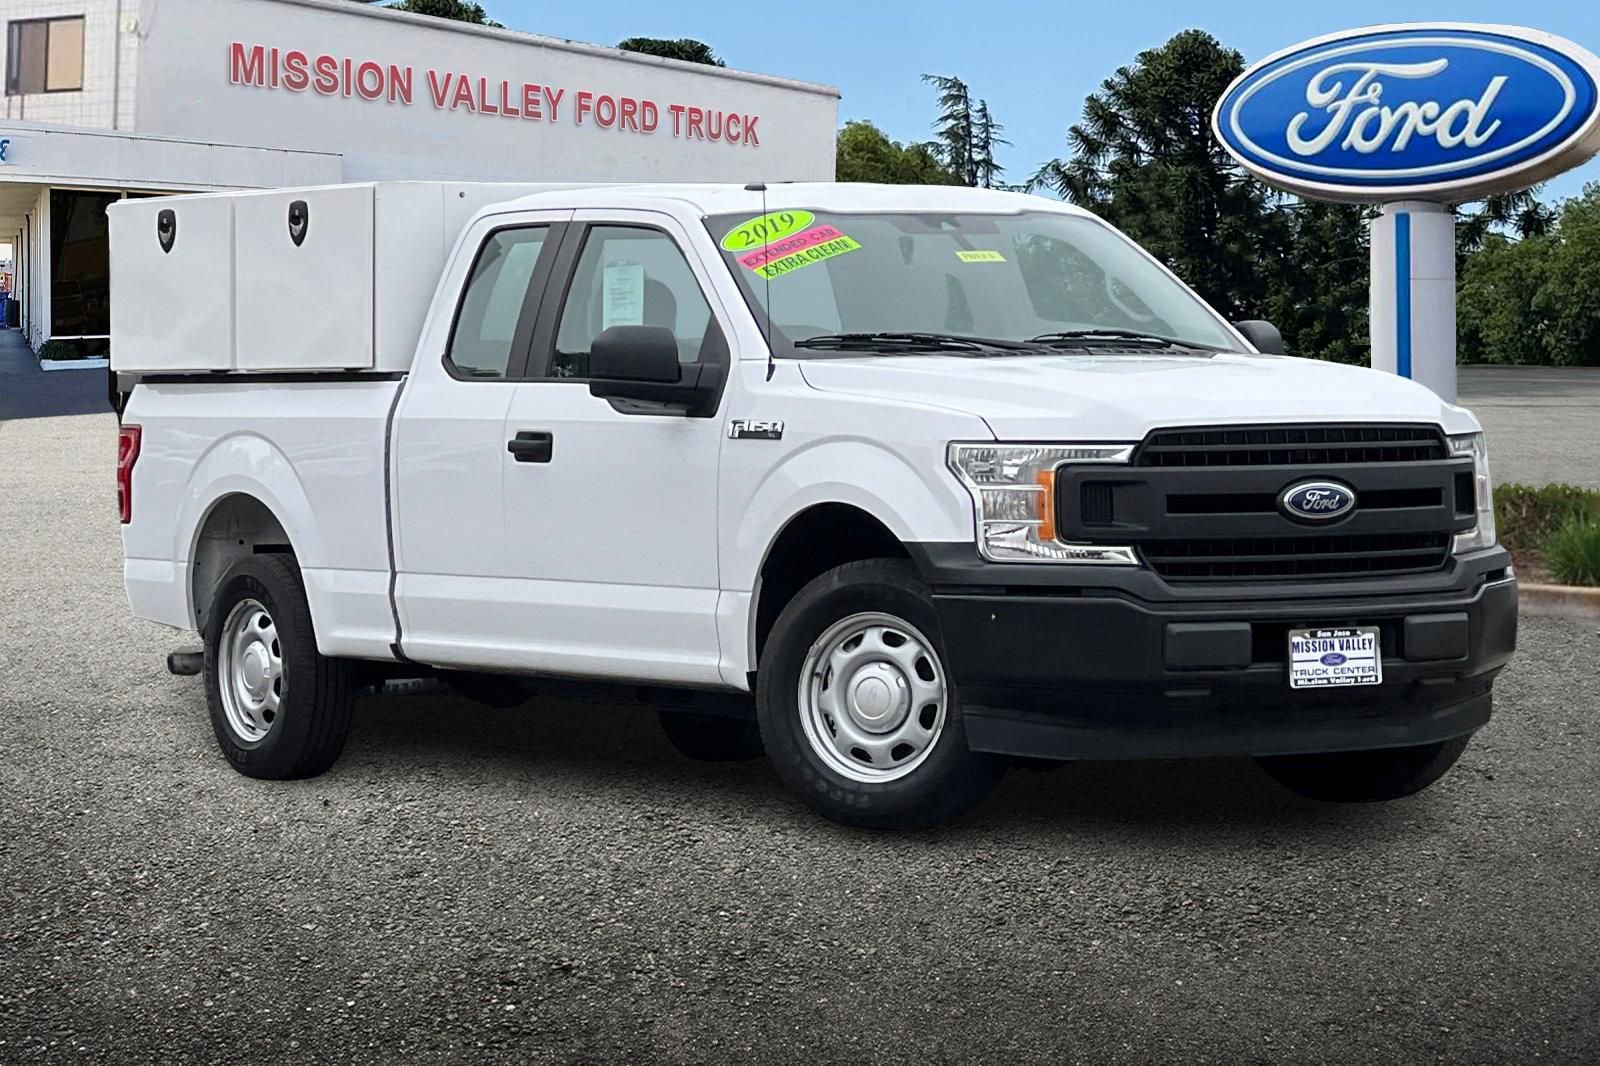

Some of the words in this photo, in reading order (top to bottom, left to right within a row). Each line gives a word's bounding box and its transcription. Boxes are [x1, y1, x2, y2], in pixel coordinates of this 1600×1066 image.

[230, 41, 413, 104] MISSION
[427, 69, 565, 122] VALLEY
[576, 90, 659, 134] FORD
[669, 104, 761, 145] TRUCK
[1286, 57, 1509, 156] Ford
[738, 213, 795, 246] 2019
[744, 238, 807, 266] EXTENDED
[762, 253, 808, 277] EXTRA
[806, 239, 849, 262] CLEAN
[1302, 490, 1340, 510] Ford
[1292, 640, 1335, 653] MISSION
[1339, 638, 1373, 651] VALLEY
[1325, 654, 1342, 664] Ford
[1294, 668, 1328, 677] TRUCK
[1333, 666, 1375, 675] CENTER
